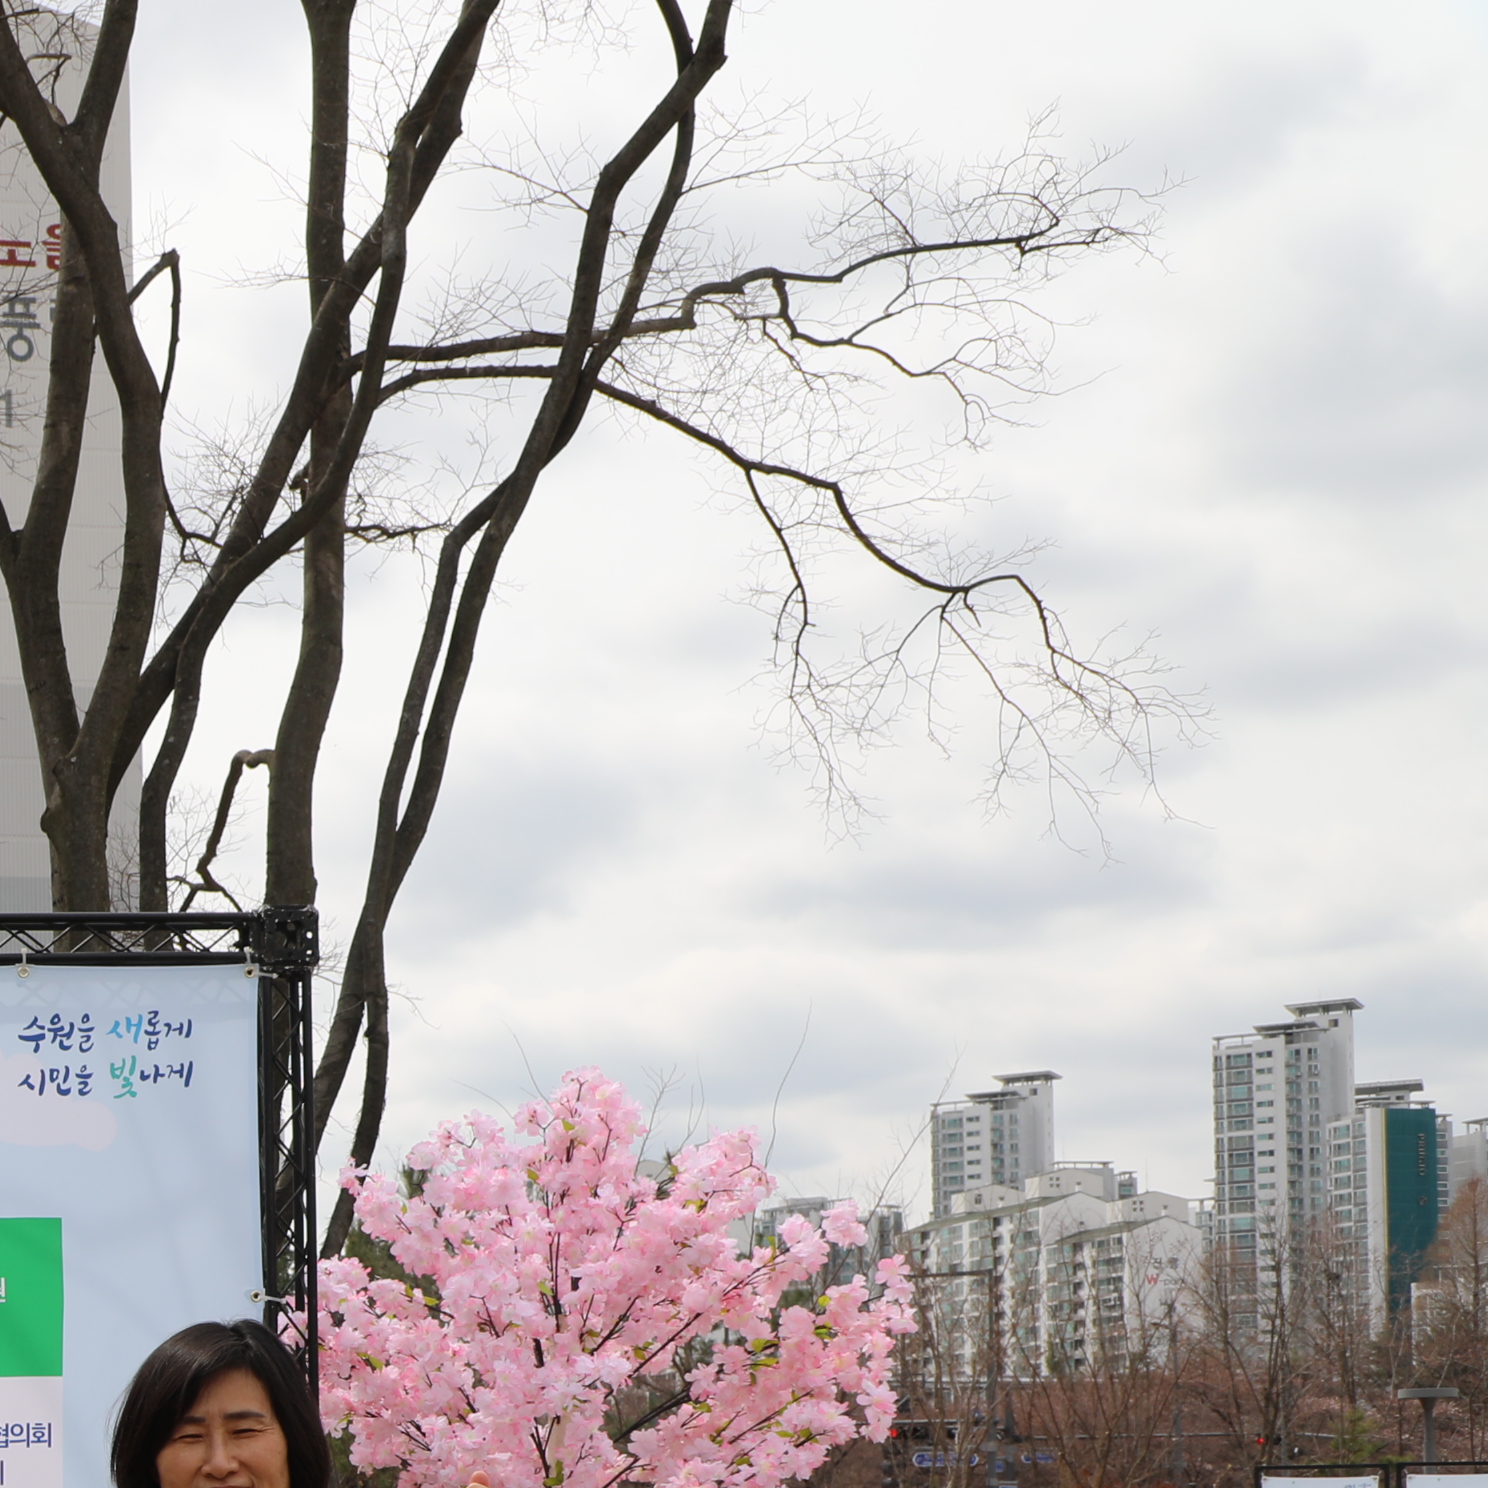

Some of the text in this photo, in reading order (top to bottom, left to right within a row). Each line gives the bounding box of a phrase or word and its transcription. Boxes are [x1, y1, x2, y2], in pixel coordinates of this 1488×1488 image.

[18, 1010, 193, 1053] 수원을 새롭게
[18, 1055, 194, 1099] 시민을 빛나게
